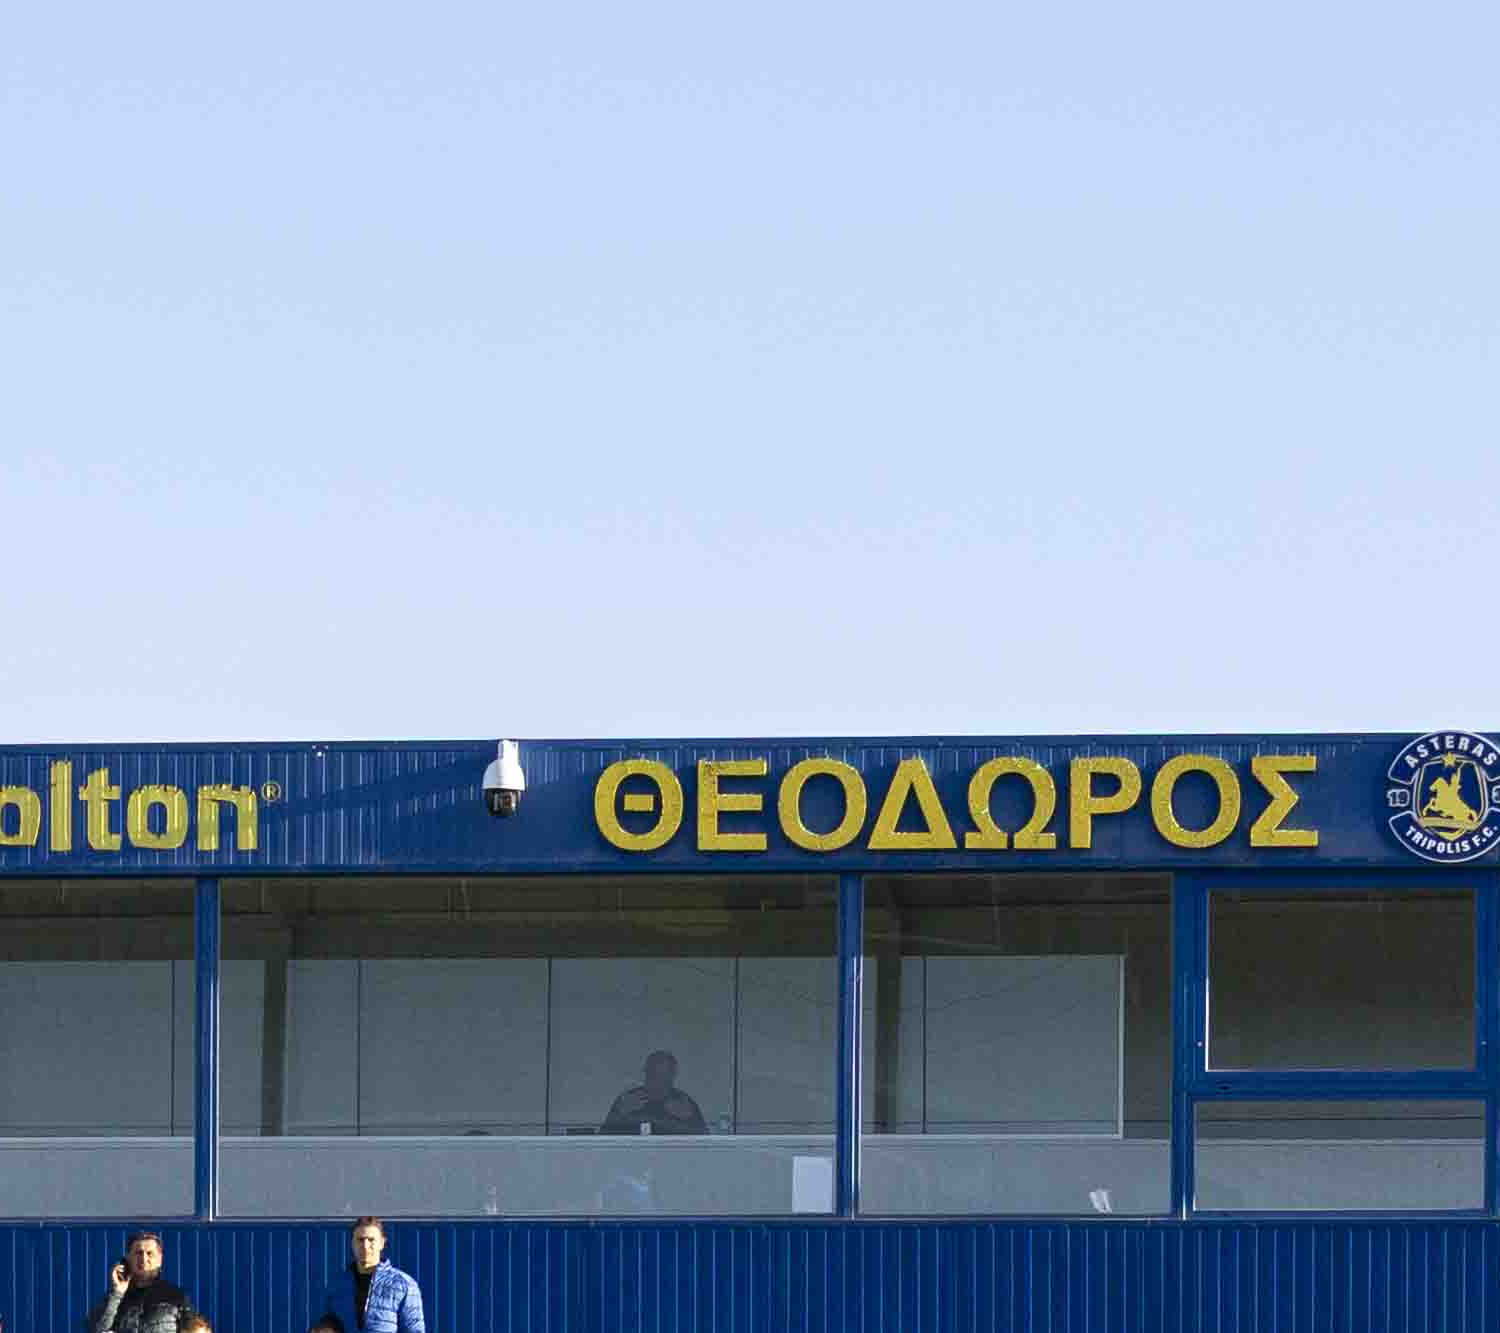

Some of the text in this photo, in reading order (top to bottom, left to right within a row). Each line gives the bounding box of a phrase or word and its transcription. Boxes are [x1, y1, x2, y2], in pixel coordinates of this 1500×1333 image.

[1404, 735, 1497, 768] ASTERAS
[594, 755, 1319, 853] ΘΕΟΔΩΡΟΣ
[1405, 825, 1499, 854] TRIPOLIS F.C.
